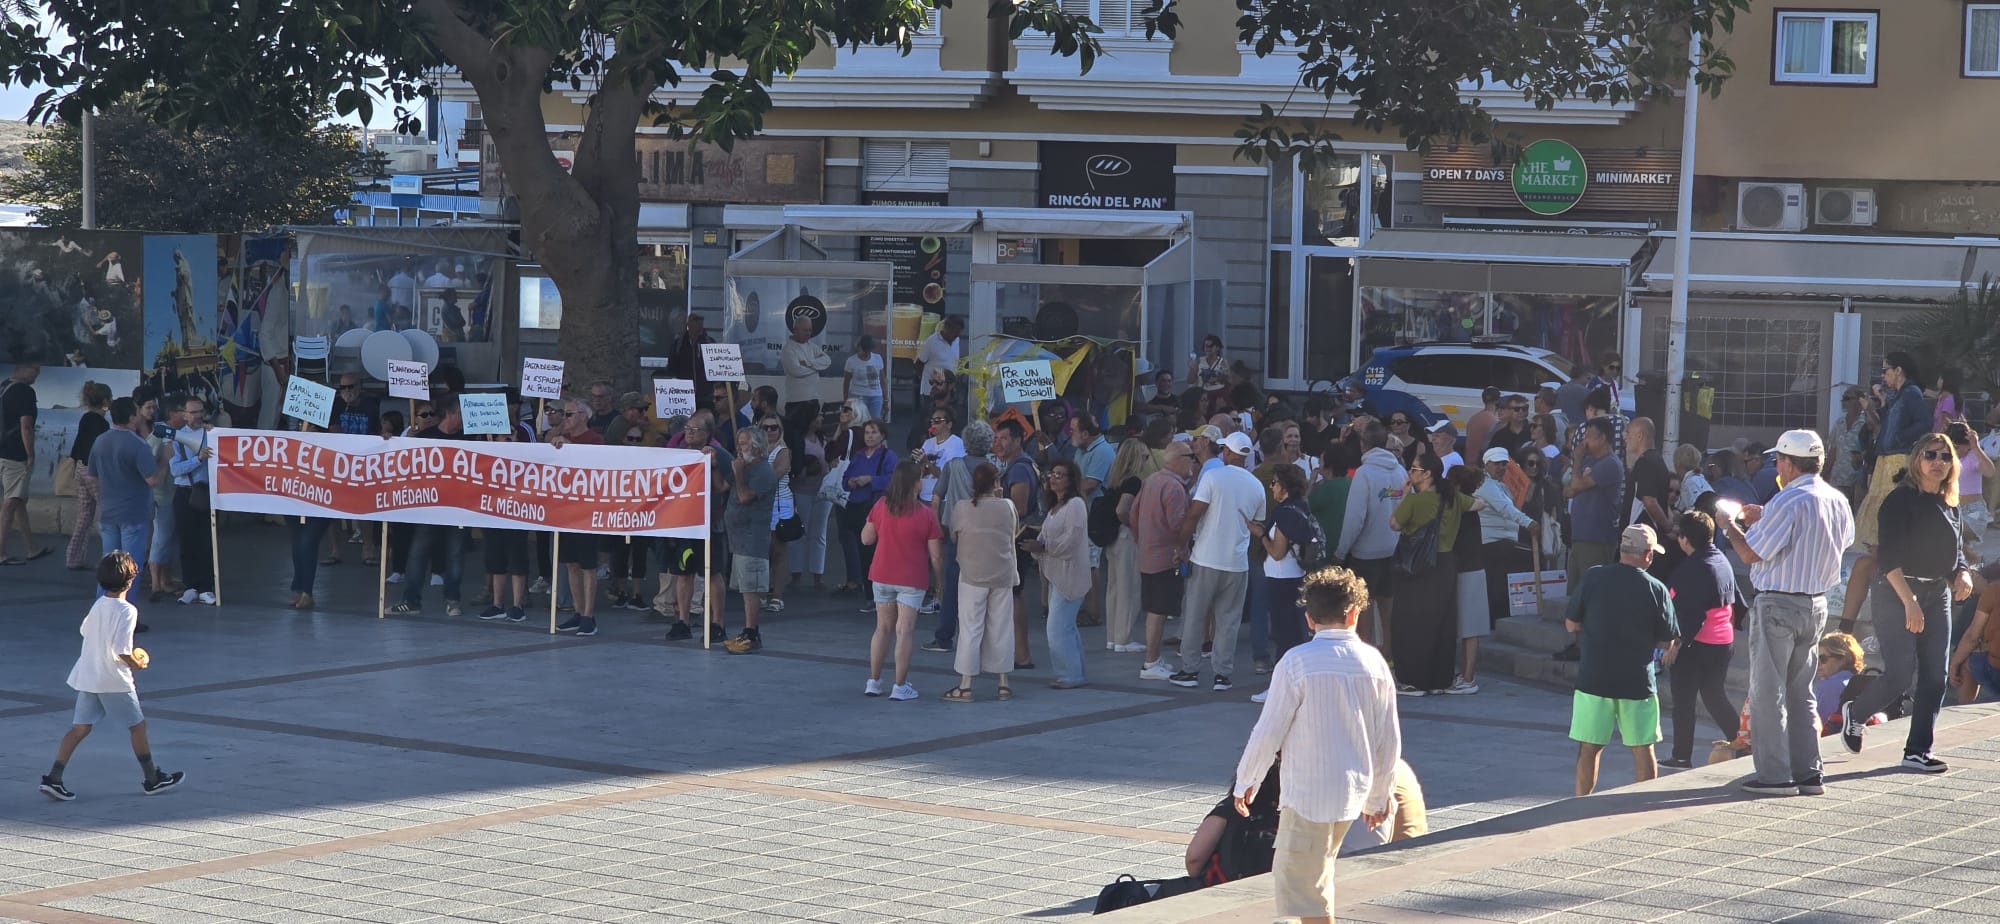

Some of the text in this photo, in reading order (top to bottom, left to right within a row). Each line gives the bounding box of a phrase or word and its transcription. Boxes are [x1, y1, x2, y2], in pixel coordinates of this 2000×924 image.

[1430, 169, 1505, 181] OPEN 7 DAYS
[1521, 174, 1578, 186] MARKET
[1596, 173, 1672, 184] MINIMARKET
[1048, 192, 1101, 207] RINCÓN
[1104, 196, 1130, 208] DEL
[1024, 368, 1039, 377] UN
[1365, 378, 1384, 386] 092
[237, 436, 687, 497] POR EL DERECHO AL APARCAMIENTO
[265, 476, 333, 505] EL MÉDANO
[376, 485, 439, 508] EL MÉDANO
[480, 494, 545, 521] EL MÉDANO
[591, 508, 656, 528] EL MÉDANO
